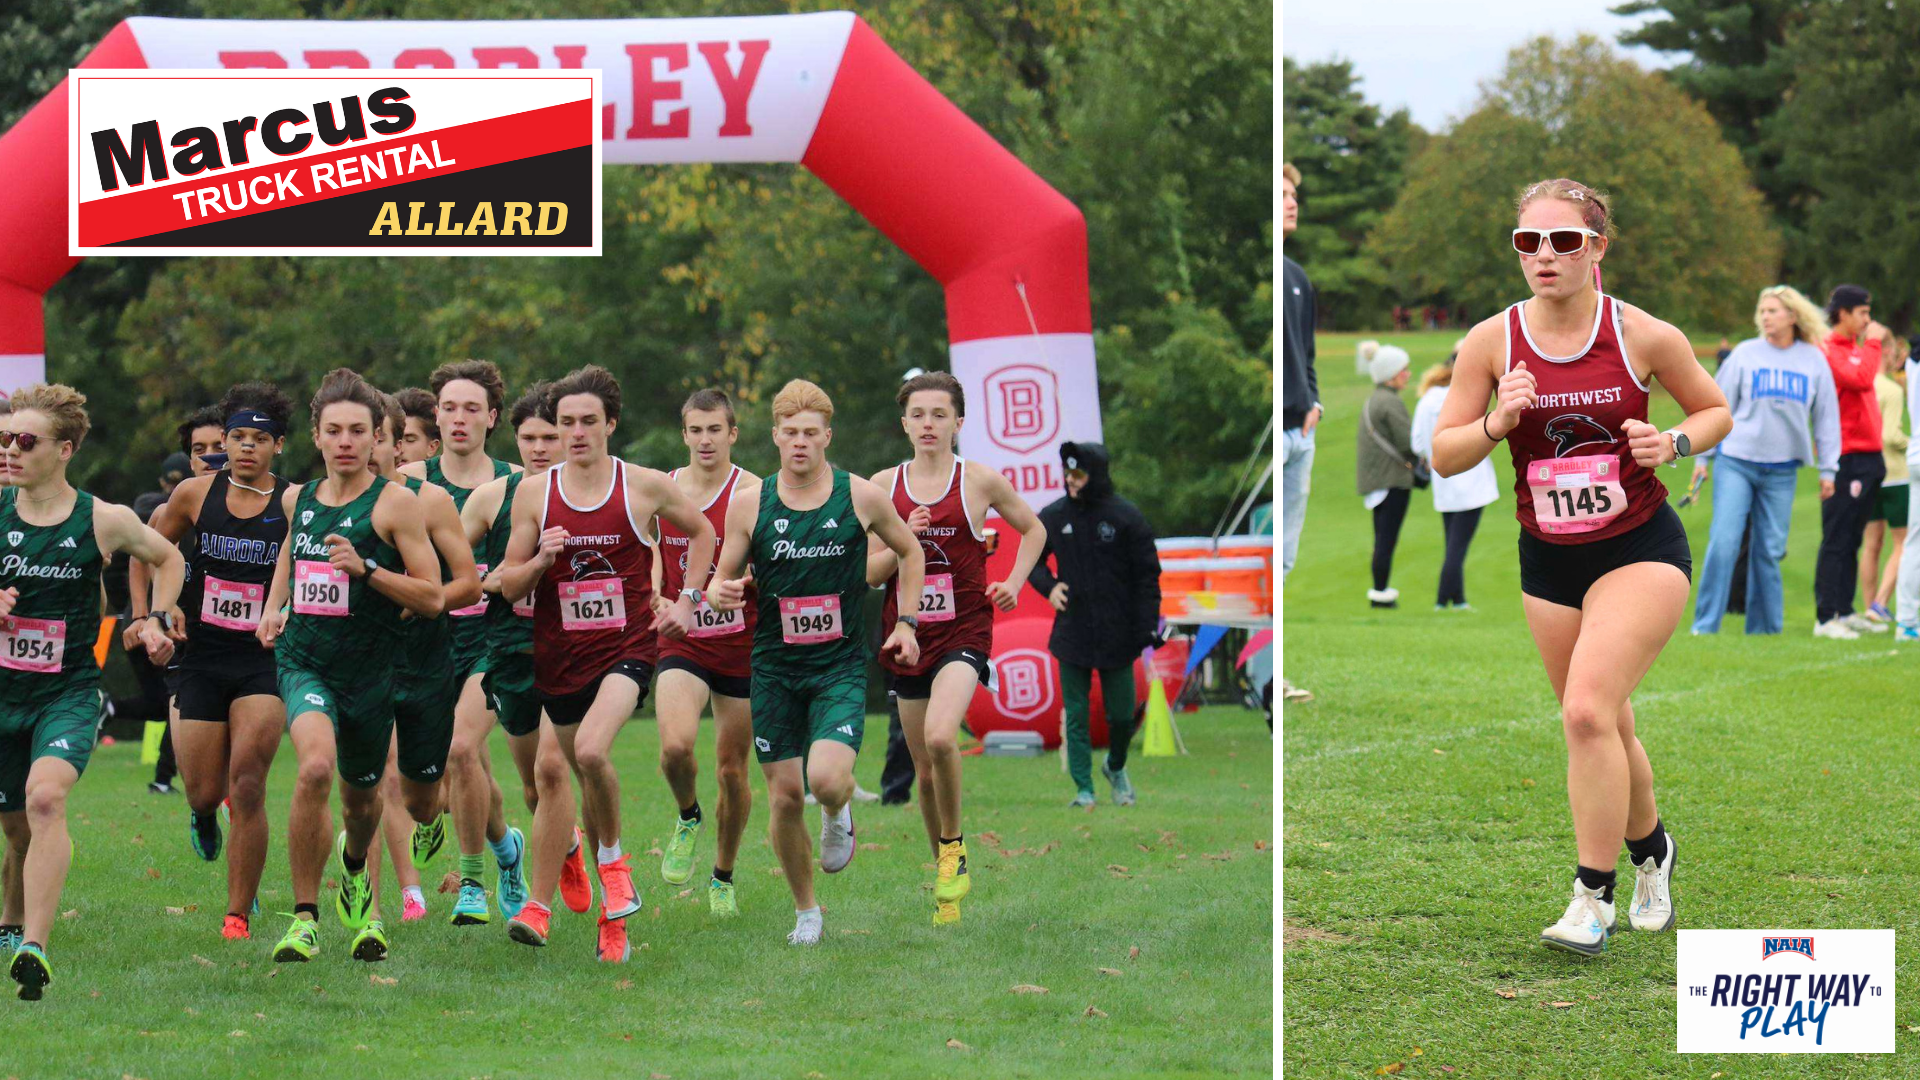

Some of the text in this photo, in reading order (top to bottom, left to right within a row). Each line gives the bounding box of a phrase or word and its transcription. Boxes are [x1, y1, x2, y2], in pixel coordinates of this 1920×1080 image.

[999, 380, 1043, 437] B
[1552, 460, 1593, 473] BRADLEY
[1547, 485, 1612, 518] 1145
[201, 532, 279, 565] AURORA
[771, 540, 846, 560] Phoenix
[0, 554, 82, 579] Phoenix
[301, 582, 340, 604] 1950
[212, 597, 251, 620] 1481
[571, 598, 614, 619] 1621
[694, 608, 735, 627] 1620
[790, 613, 833, 634] 1949
[8, 636, 54, 661] 1954
